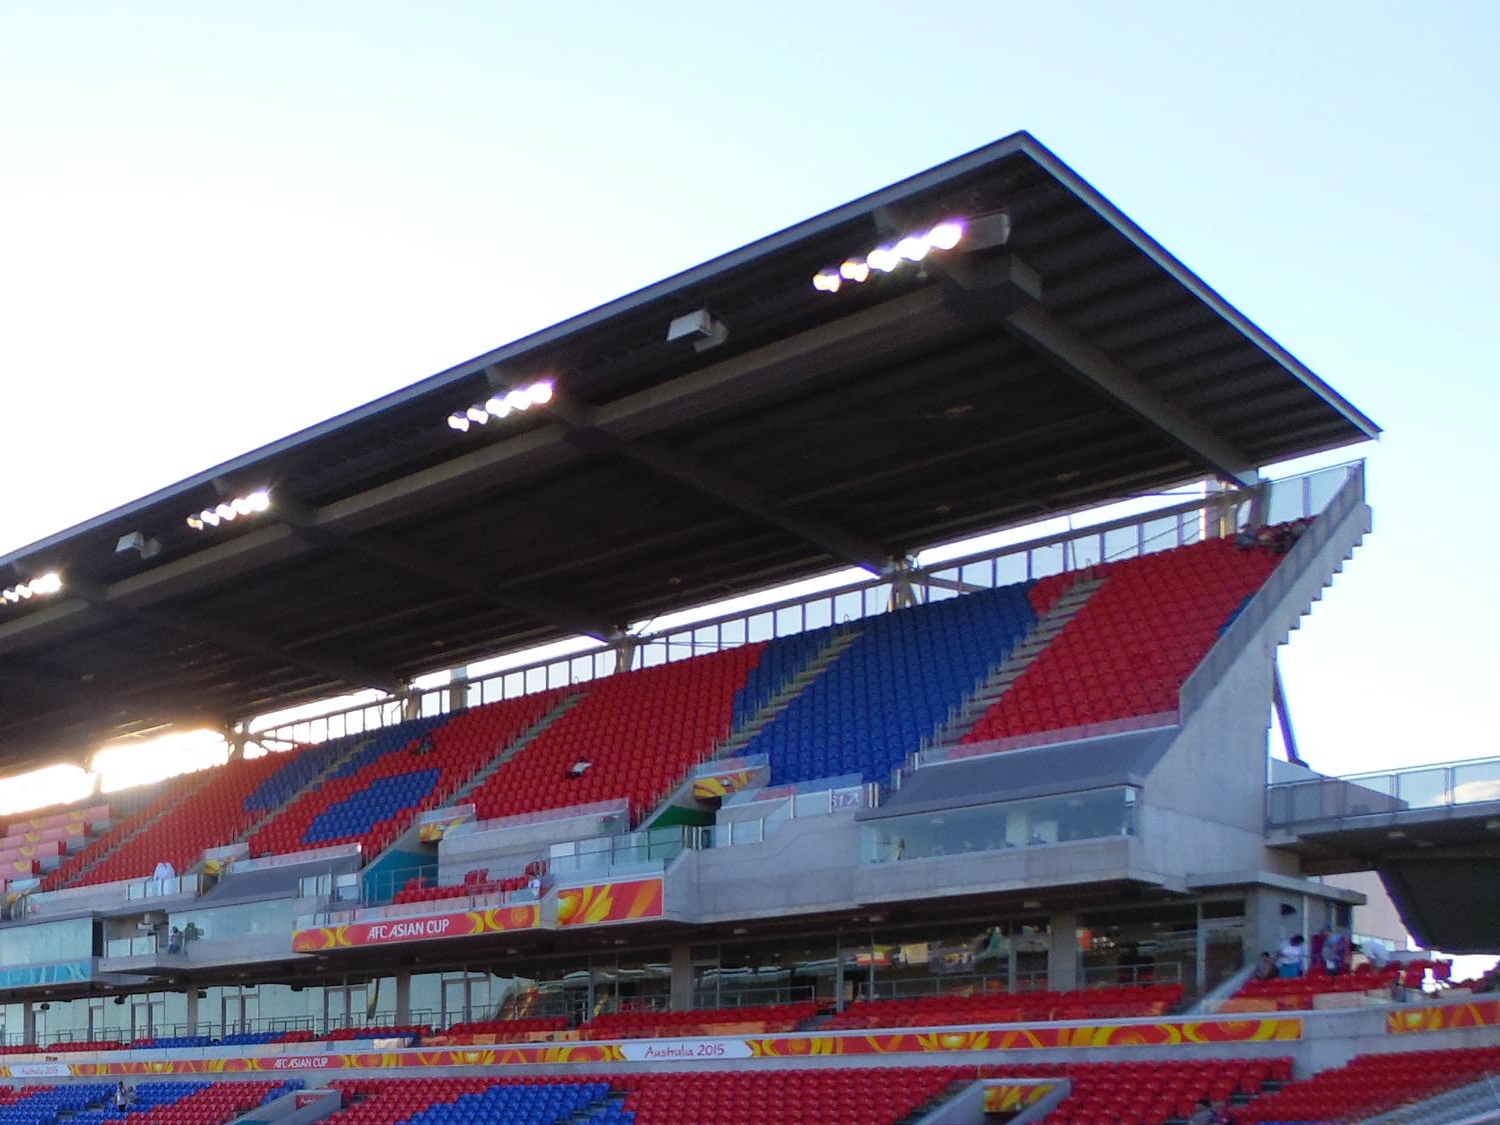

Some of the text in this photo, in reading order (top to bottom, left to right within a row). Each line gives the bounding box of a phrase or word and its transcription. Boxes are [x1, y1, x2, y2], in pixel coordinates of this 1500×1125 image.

[367, 919, 450, 940] AFC ASIAN CUP
[644, 1043, 725, 1058] Australia 2015
[273, 1057, 328, 1069] AFC ASIAN CUP
